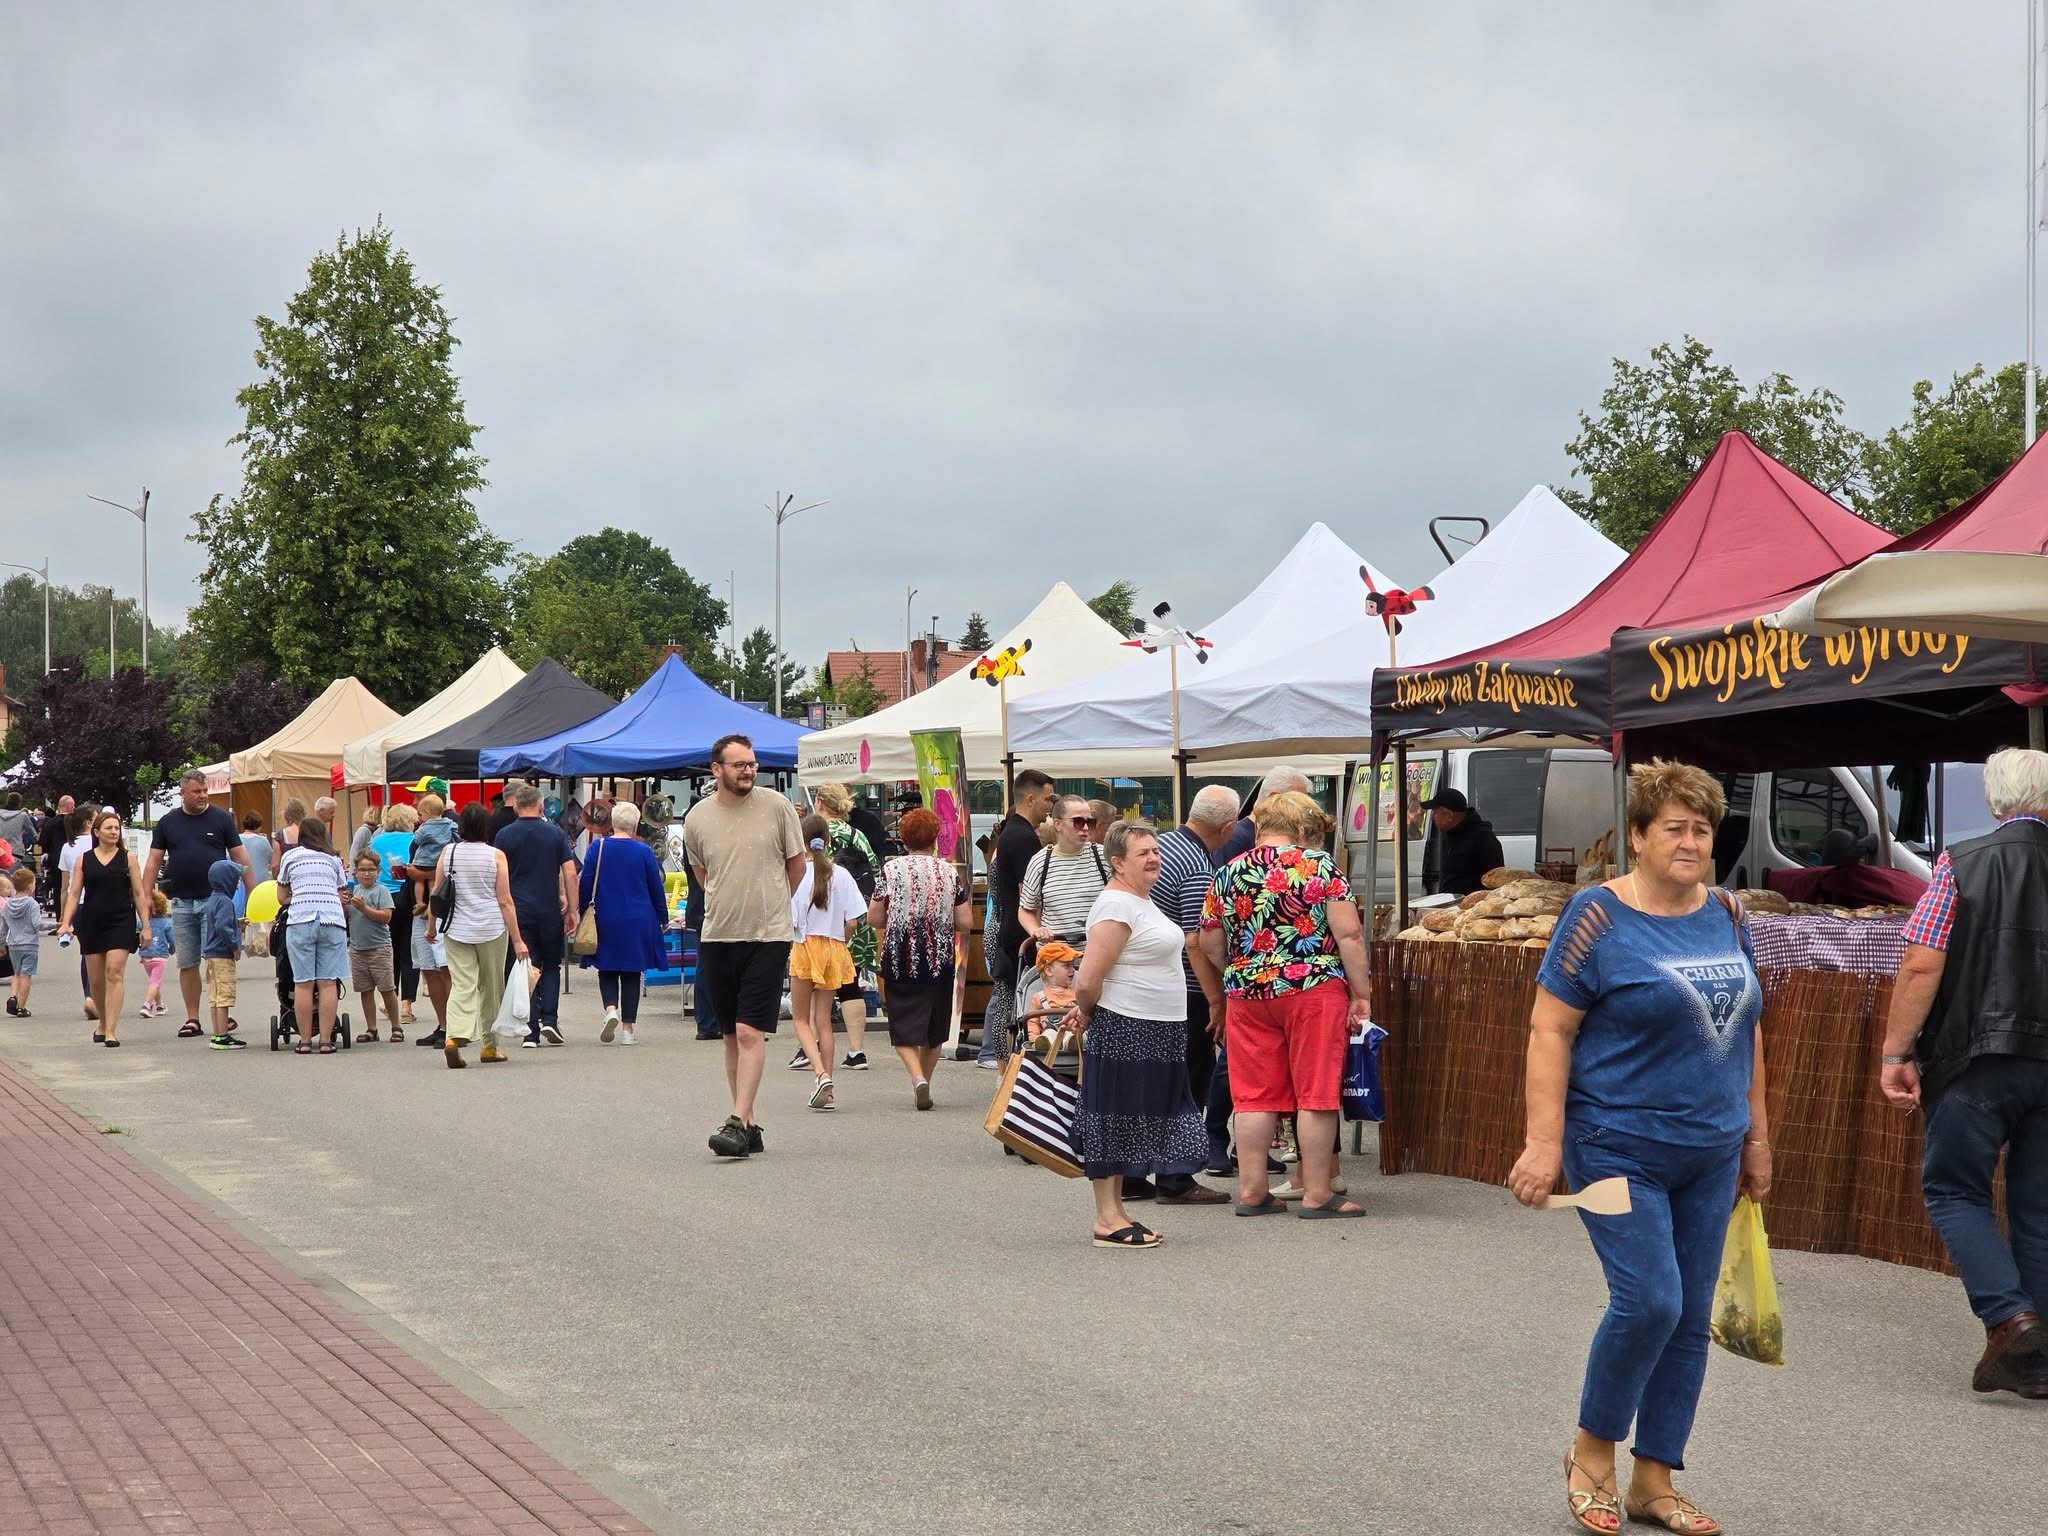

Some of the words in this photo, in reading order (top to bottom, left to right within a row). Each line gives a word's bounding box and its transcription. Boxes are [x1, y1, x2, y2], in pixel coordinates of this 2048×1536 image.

[1648, 616, 1812, 702] Swojskie
[1451, 673, 1474, 707] na
[807, 754, 832, 769] WINNICA
[832, 752, 857, 766] JAROCH
[1406, 768, 1431, 781] ROCH
[1683, 965, 1744, 981] CHARM
